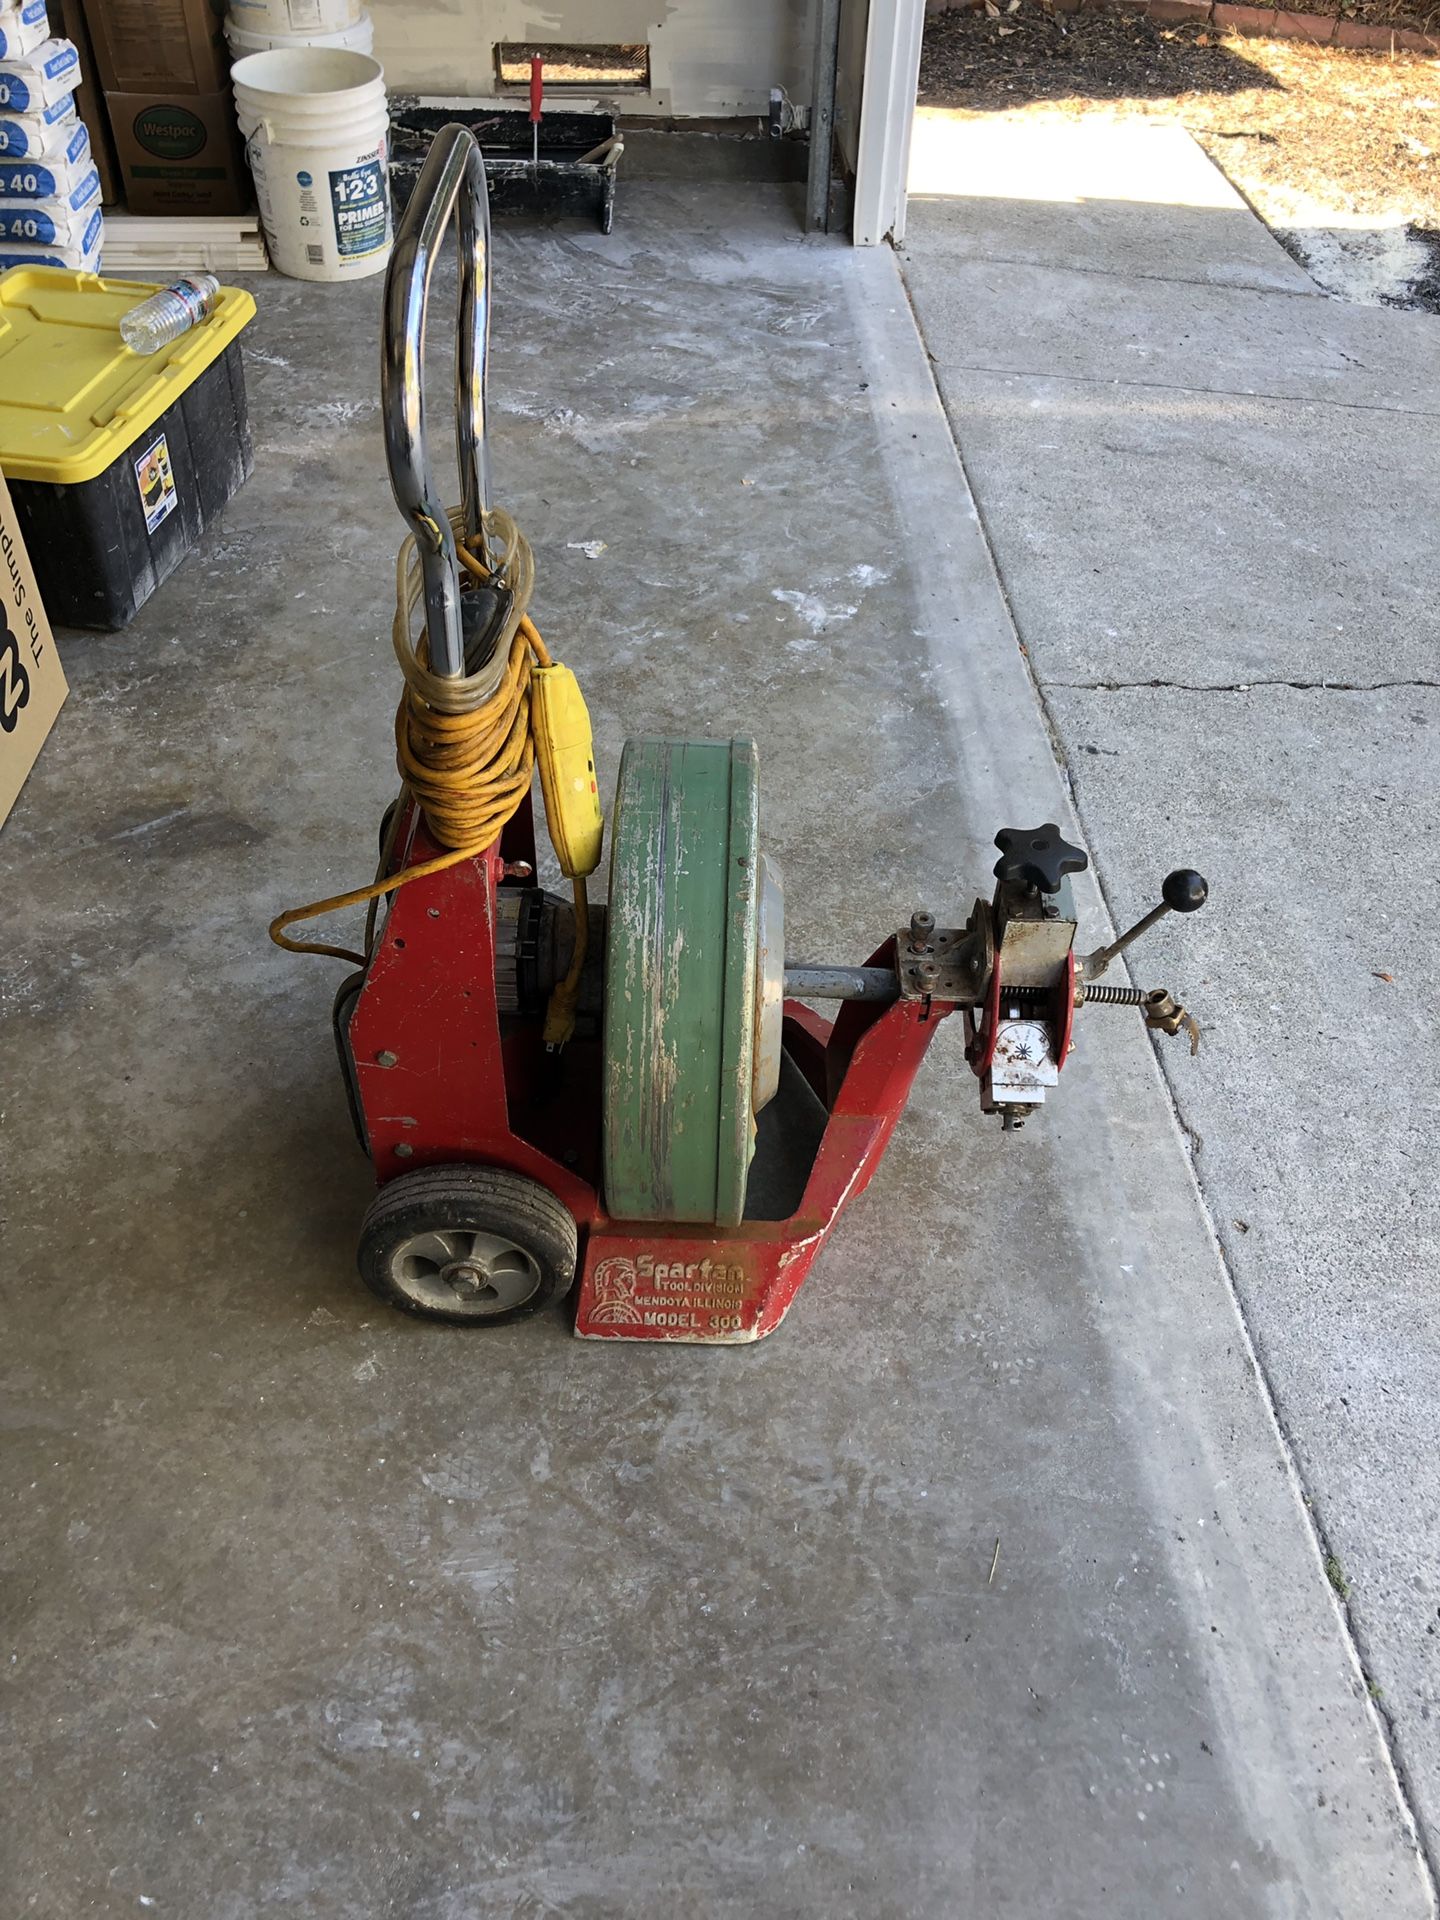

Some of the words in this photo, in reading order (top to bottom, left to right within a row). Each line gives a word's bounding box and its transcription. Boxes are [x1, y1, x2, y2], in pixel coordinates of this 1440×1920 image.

[143, 122, 196, 139] Westpac
[10, 173, 37, 192] 40
[338, 201, 385, 225] PRIMER
[11, 219, 37, 238] 40
[25, 607, 43, 669] The
[636, 1254, 745, 1290] Spartan
[661, 1281, 693, 1293] TOOL
[694, 1282, 744, 1295] DIVISION
[693, 1297, 743, 1311] ILLINOIS
[643, 1311, 701, 1328] MODEL
[708, 1315, 743, 1330] 300
